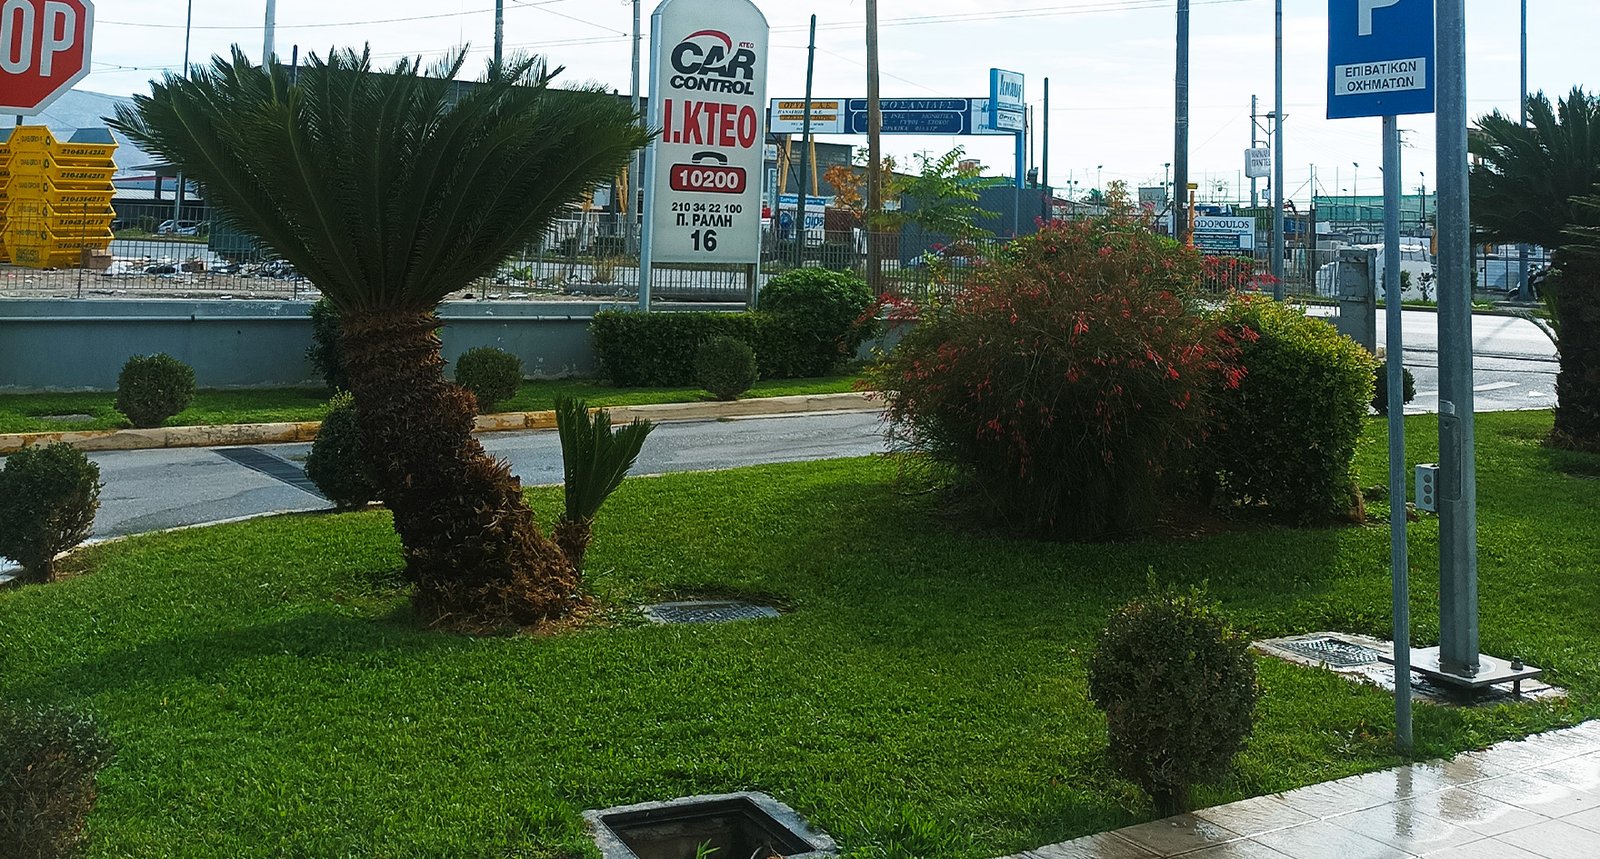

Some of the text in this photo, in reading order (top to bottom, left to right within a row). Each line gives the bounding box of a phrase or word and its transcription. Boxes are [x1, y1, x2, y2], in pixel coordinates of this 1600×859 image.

[671, 42, 756, 80] CAR
[1345, 61, 1416, 77] ΕΠΙΒΑΤΙΚΩΝ
[670, 75, 754, 95] CONTROL
[1347, 77, 1414, 91] ΟΧΗΜΑΤΩΝ
[680, 169, 739, 189] 10200
[672, 202, 742, 213] 210 34 22 100
[676, 213, 733, 227] Π. ΡΑΛΛΗ
[691, 229, 717, 252] 16
